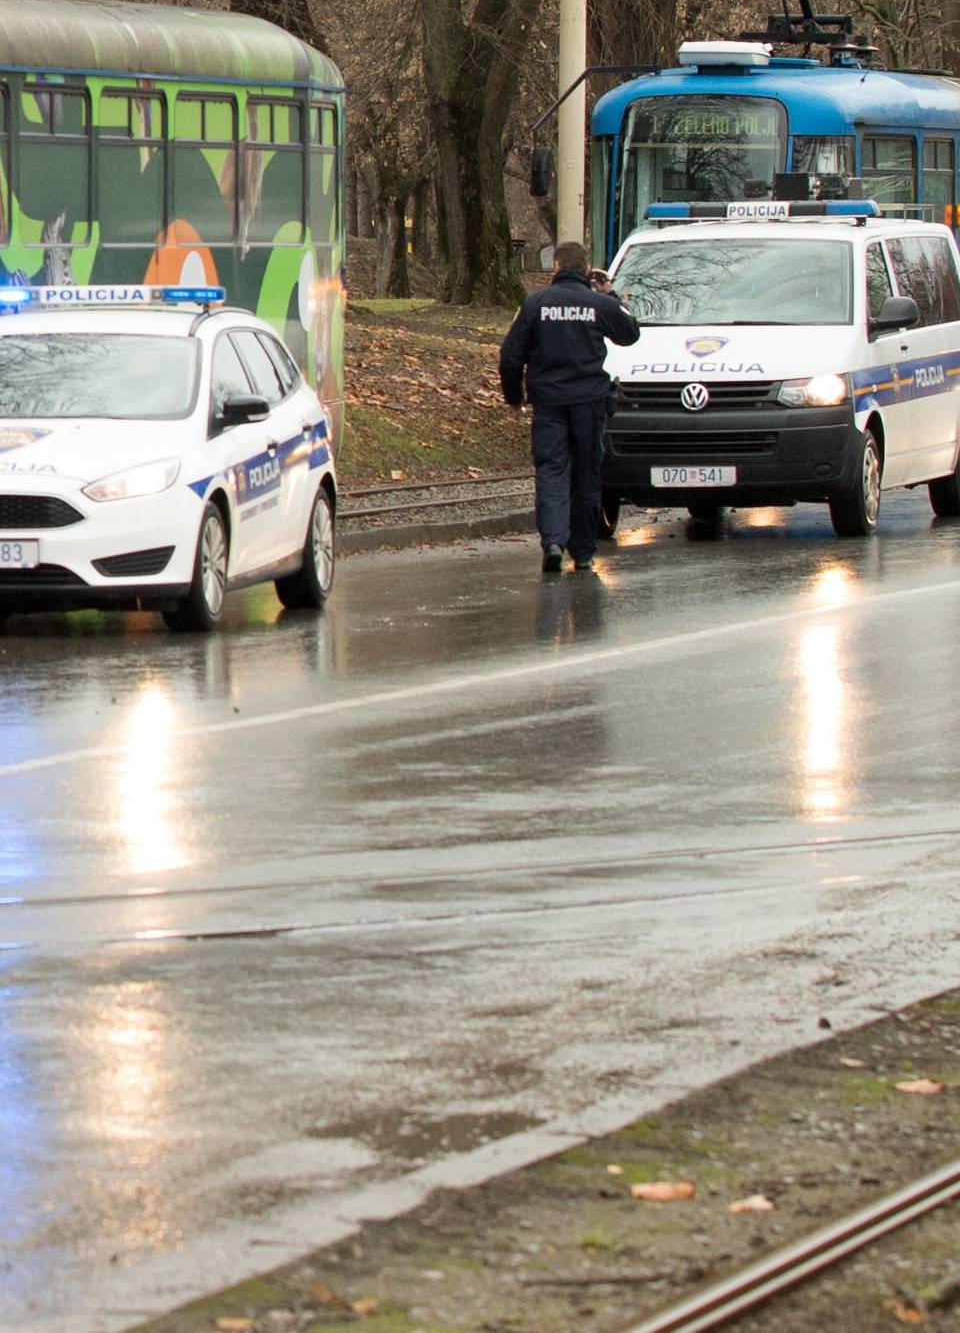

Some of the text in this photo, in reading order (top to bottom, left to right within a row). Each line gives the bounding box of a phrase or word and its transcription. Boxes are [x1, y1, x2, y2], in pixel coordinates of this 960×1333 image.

[729, 205, 787, 217] POLICIJA
[45, 289, 145, 301] POLICIJA
[540, 306, 596, 322] POLICIJA
[630, 362, 766, 376] POLICIJA
[662, 468, 723, 483] 070 541
